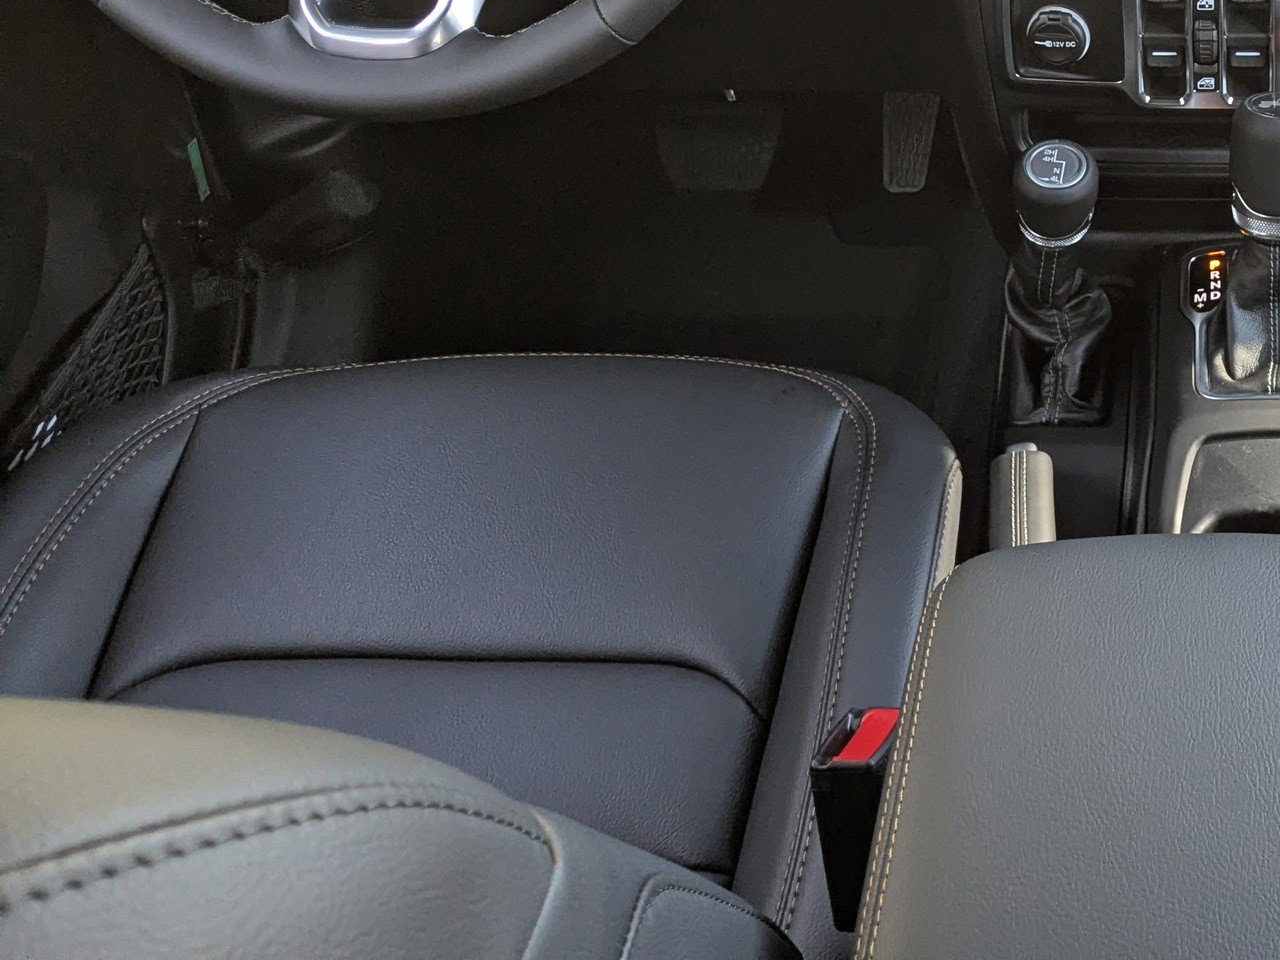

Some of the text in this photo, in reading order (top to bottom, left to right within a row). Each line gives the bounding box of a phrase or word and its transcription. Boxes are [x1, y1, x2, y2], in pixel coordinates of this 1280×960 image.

[1209, 259, 1221, 270] P
[1210, 270, 1220, 280] R
[1210, 280, 1221, 290] N
[1193, 292, 1207, 303] M
[1210, 291, 1221, 300] D
